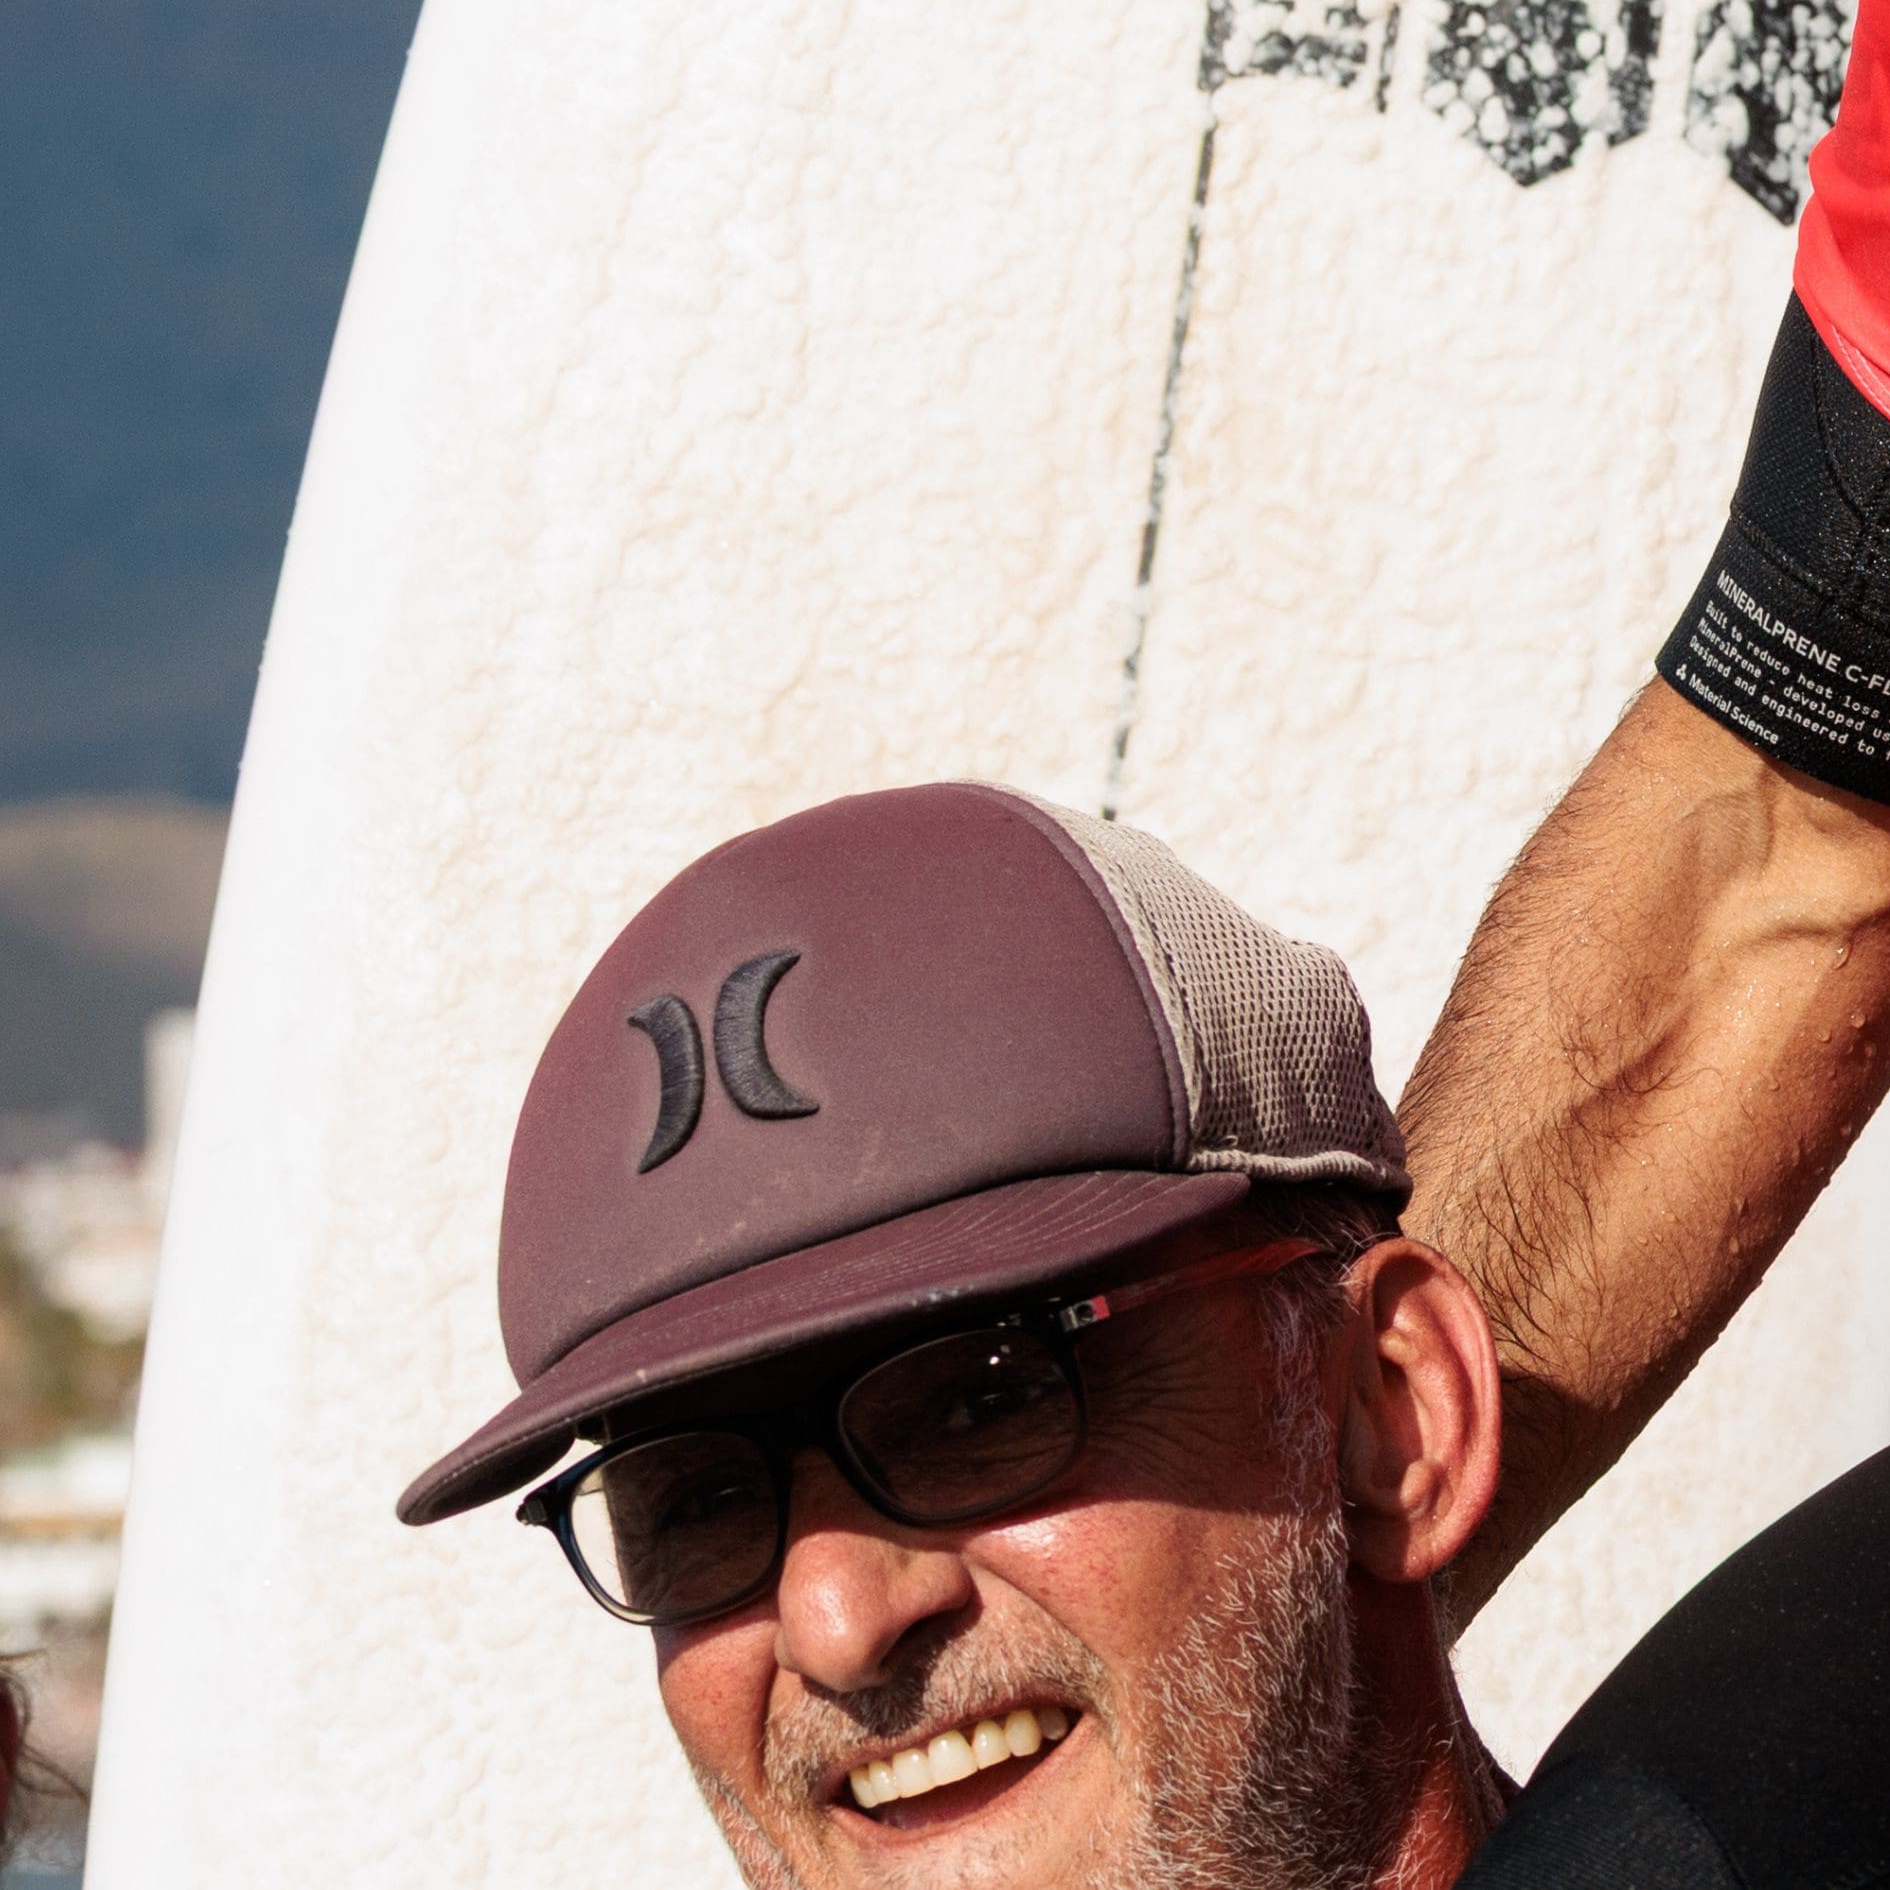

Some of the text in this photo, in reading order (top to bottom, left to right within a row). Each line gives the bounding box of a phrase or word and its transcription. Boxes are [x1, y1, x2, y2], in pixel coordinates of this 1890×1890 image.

[1705, 599, 1729, 630] Built
[1731, 625, 1743, 643] to
[1797, 671, 1833, 699] heat
[1842, 694, 1881, 719] loss
[1716, 569, 1842, 674] MINERALPRENE
[1688, 672, 1780, 746] Material Science
[1689, 634, 1732, 678] Designed
[1734, 675, 1758, 697] and
[1761, 693, 1850, 745] engineered
[1857, 738, 1876, 756] to
[1783, 684, 1866, 732] developed
